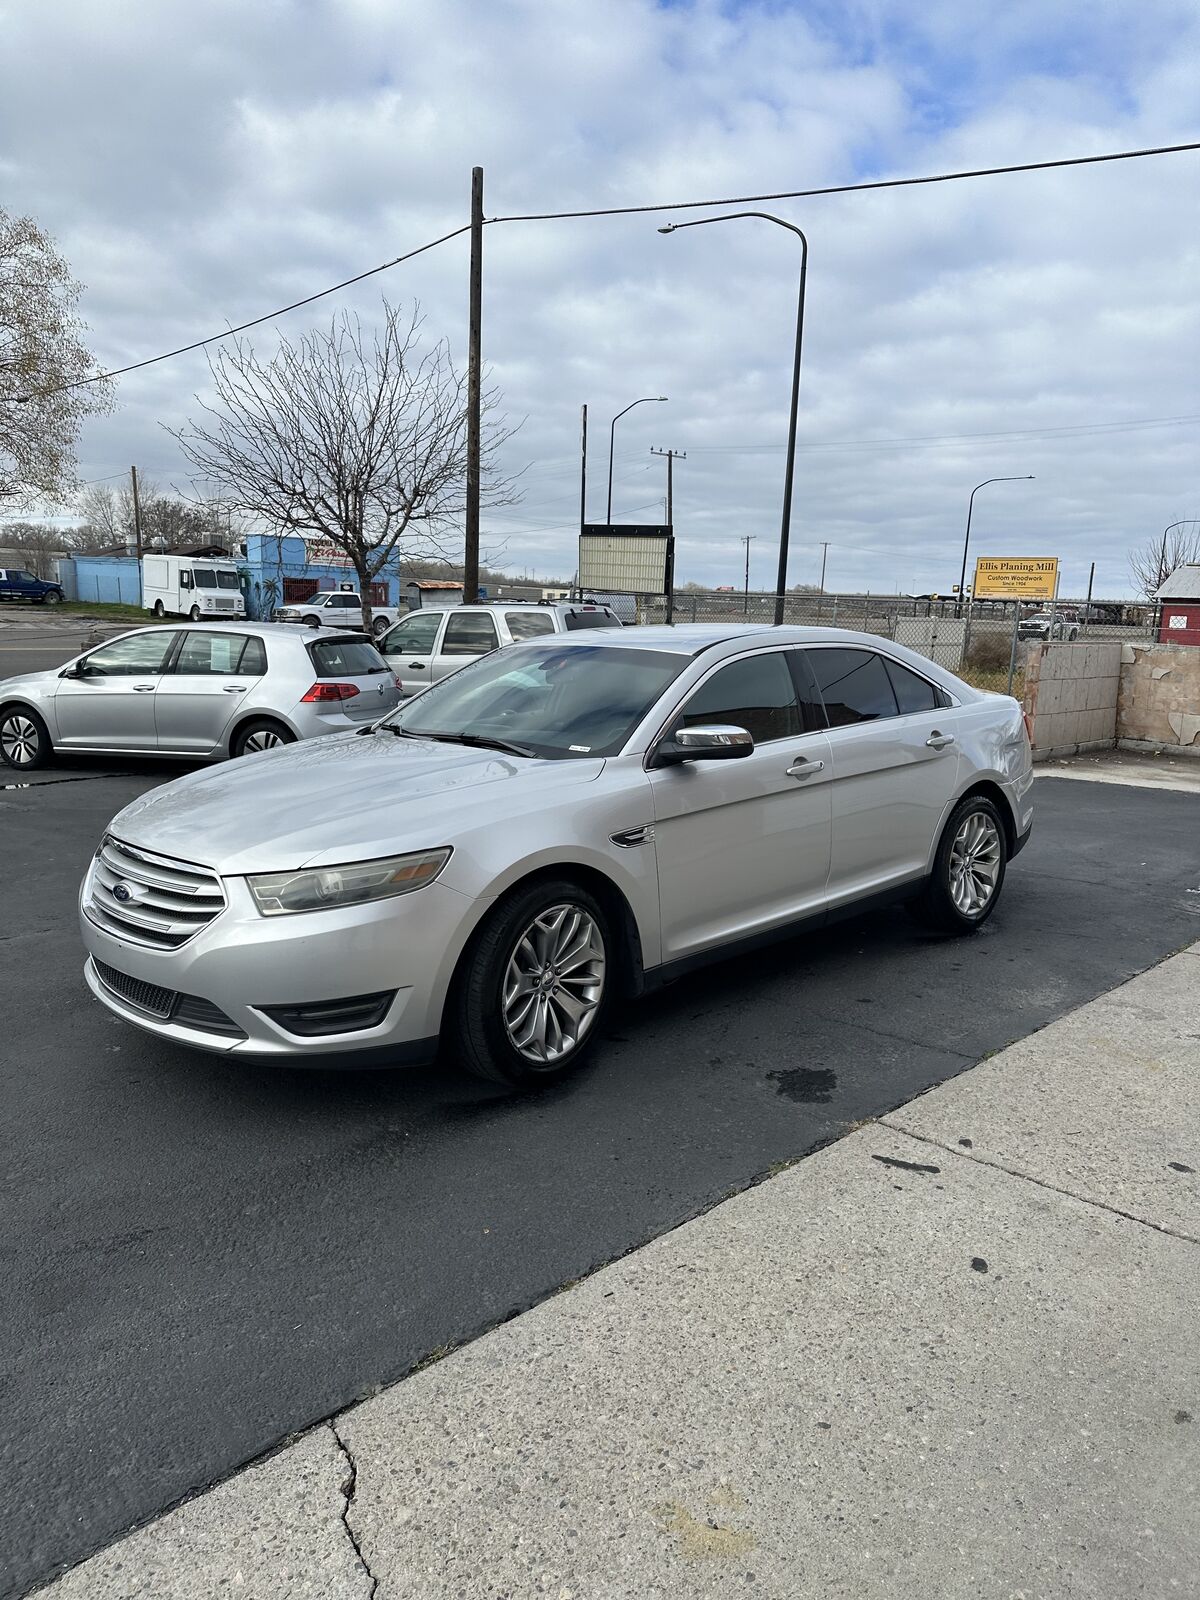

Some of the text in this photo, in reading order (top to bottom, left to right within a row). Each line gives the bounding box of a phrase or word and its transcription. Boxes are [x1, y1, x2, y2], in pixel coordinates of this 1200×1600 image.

[980, 562, 1054, 572] Ellis Planing Mill
